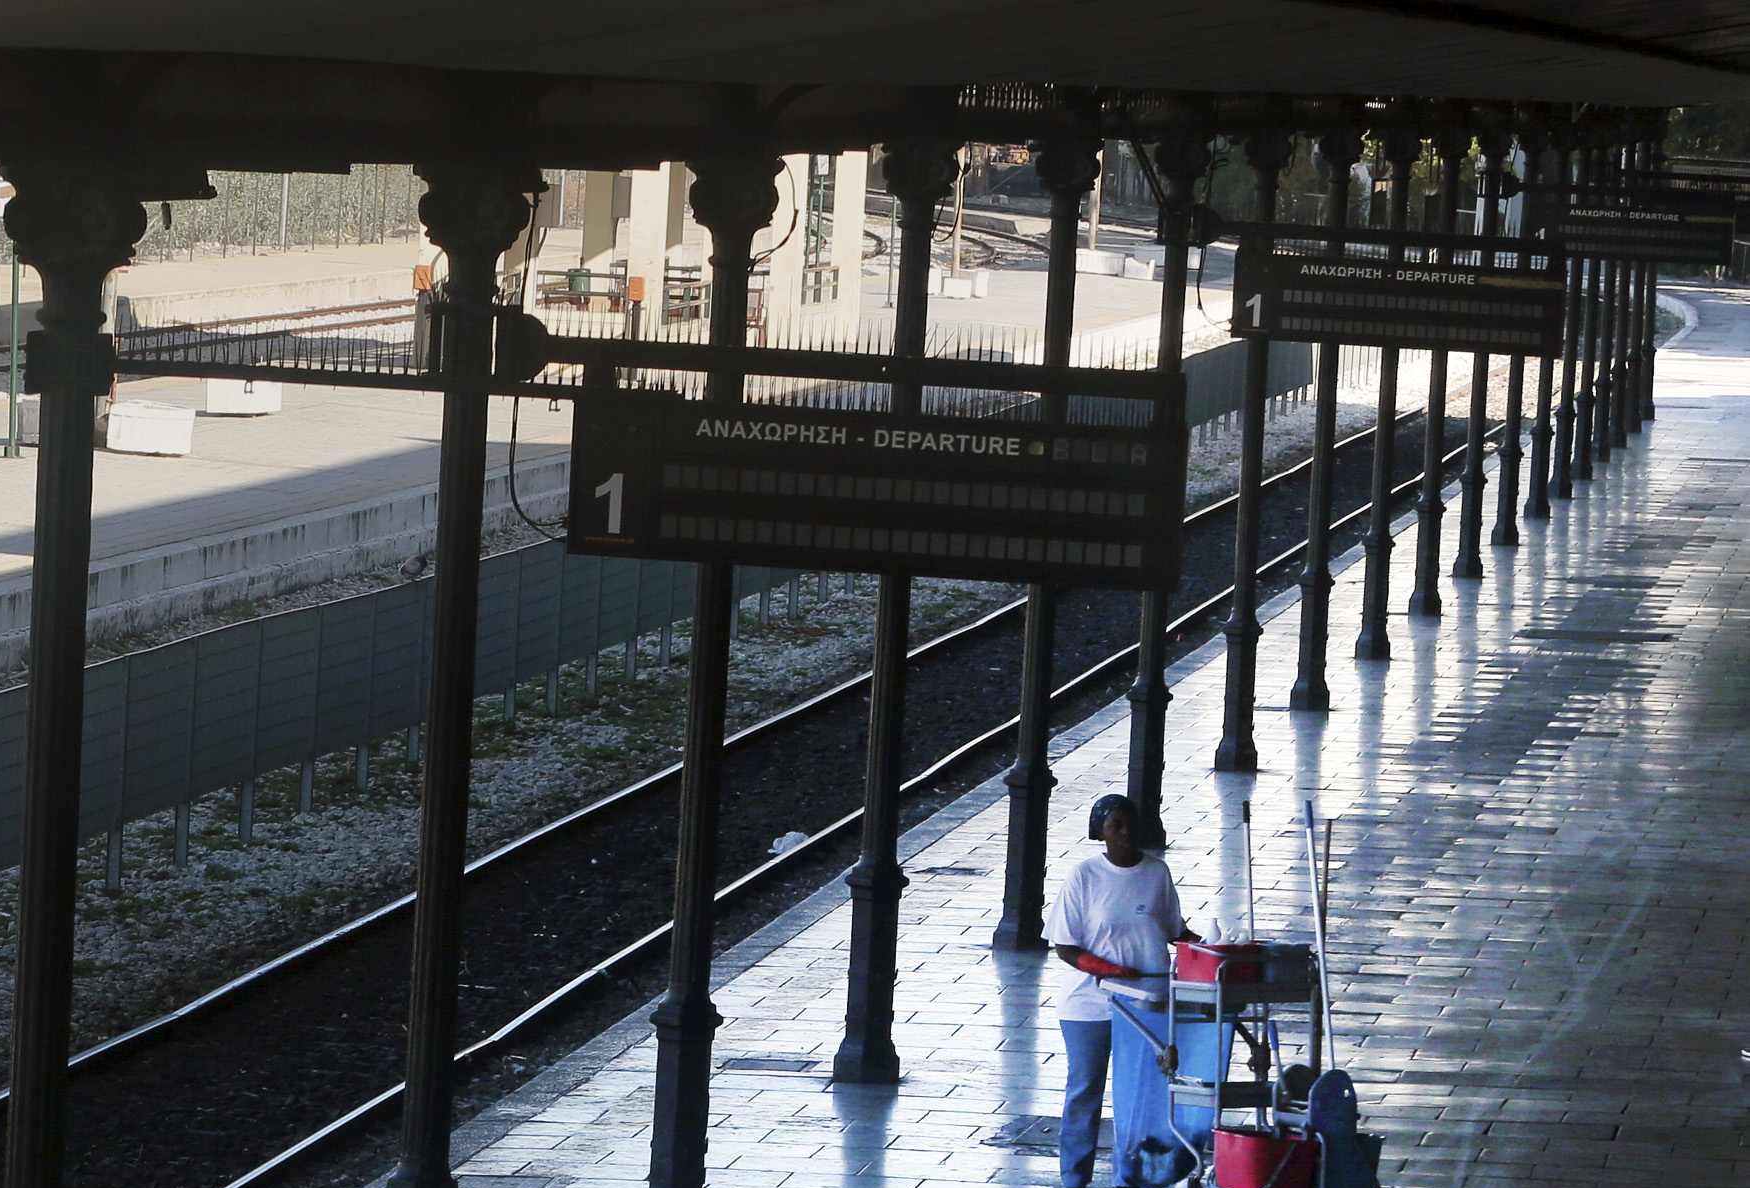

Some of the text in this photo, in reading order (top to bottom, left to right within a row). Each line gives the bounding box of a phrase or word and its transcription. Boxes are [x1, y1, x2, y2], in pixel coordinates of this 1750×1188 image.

[1629, 210, 1680, 222] DEPARTURE
[1300, 264, 1382, 280] ΑΝΑΧΩΡΗΣΗ
[1396, 269, 1475, 285] DEPARTURE
[1244, 293, 1262, 328] 1
[695, 418, 847, 446] ΑΝΑΧΩΡΗΣΗ
[873, 429, 1021, 457] DEPARTURE
[594, 472, 624, 535] 1
